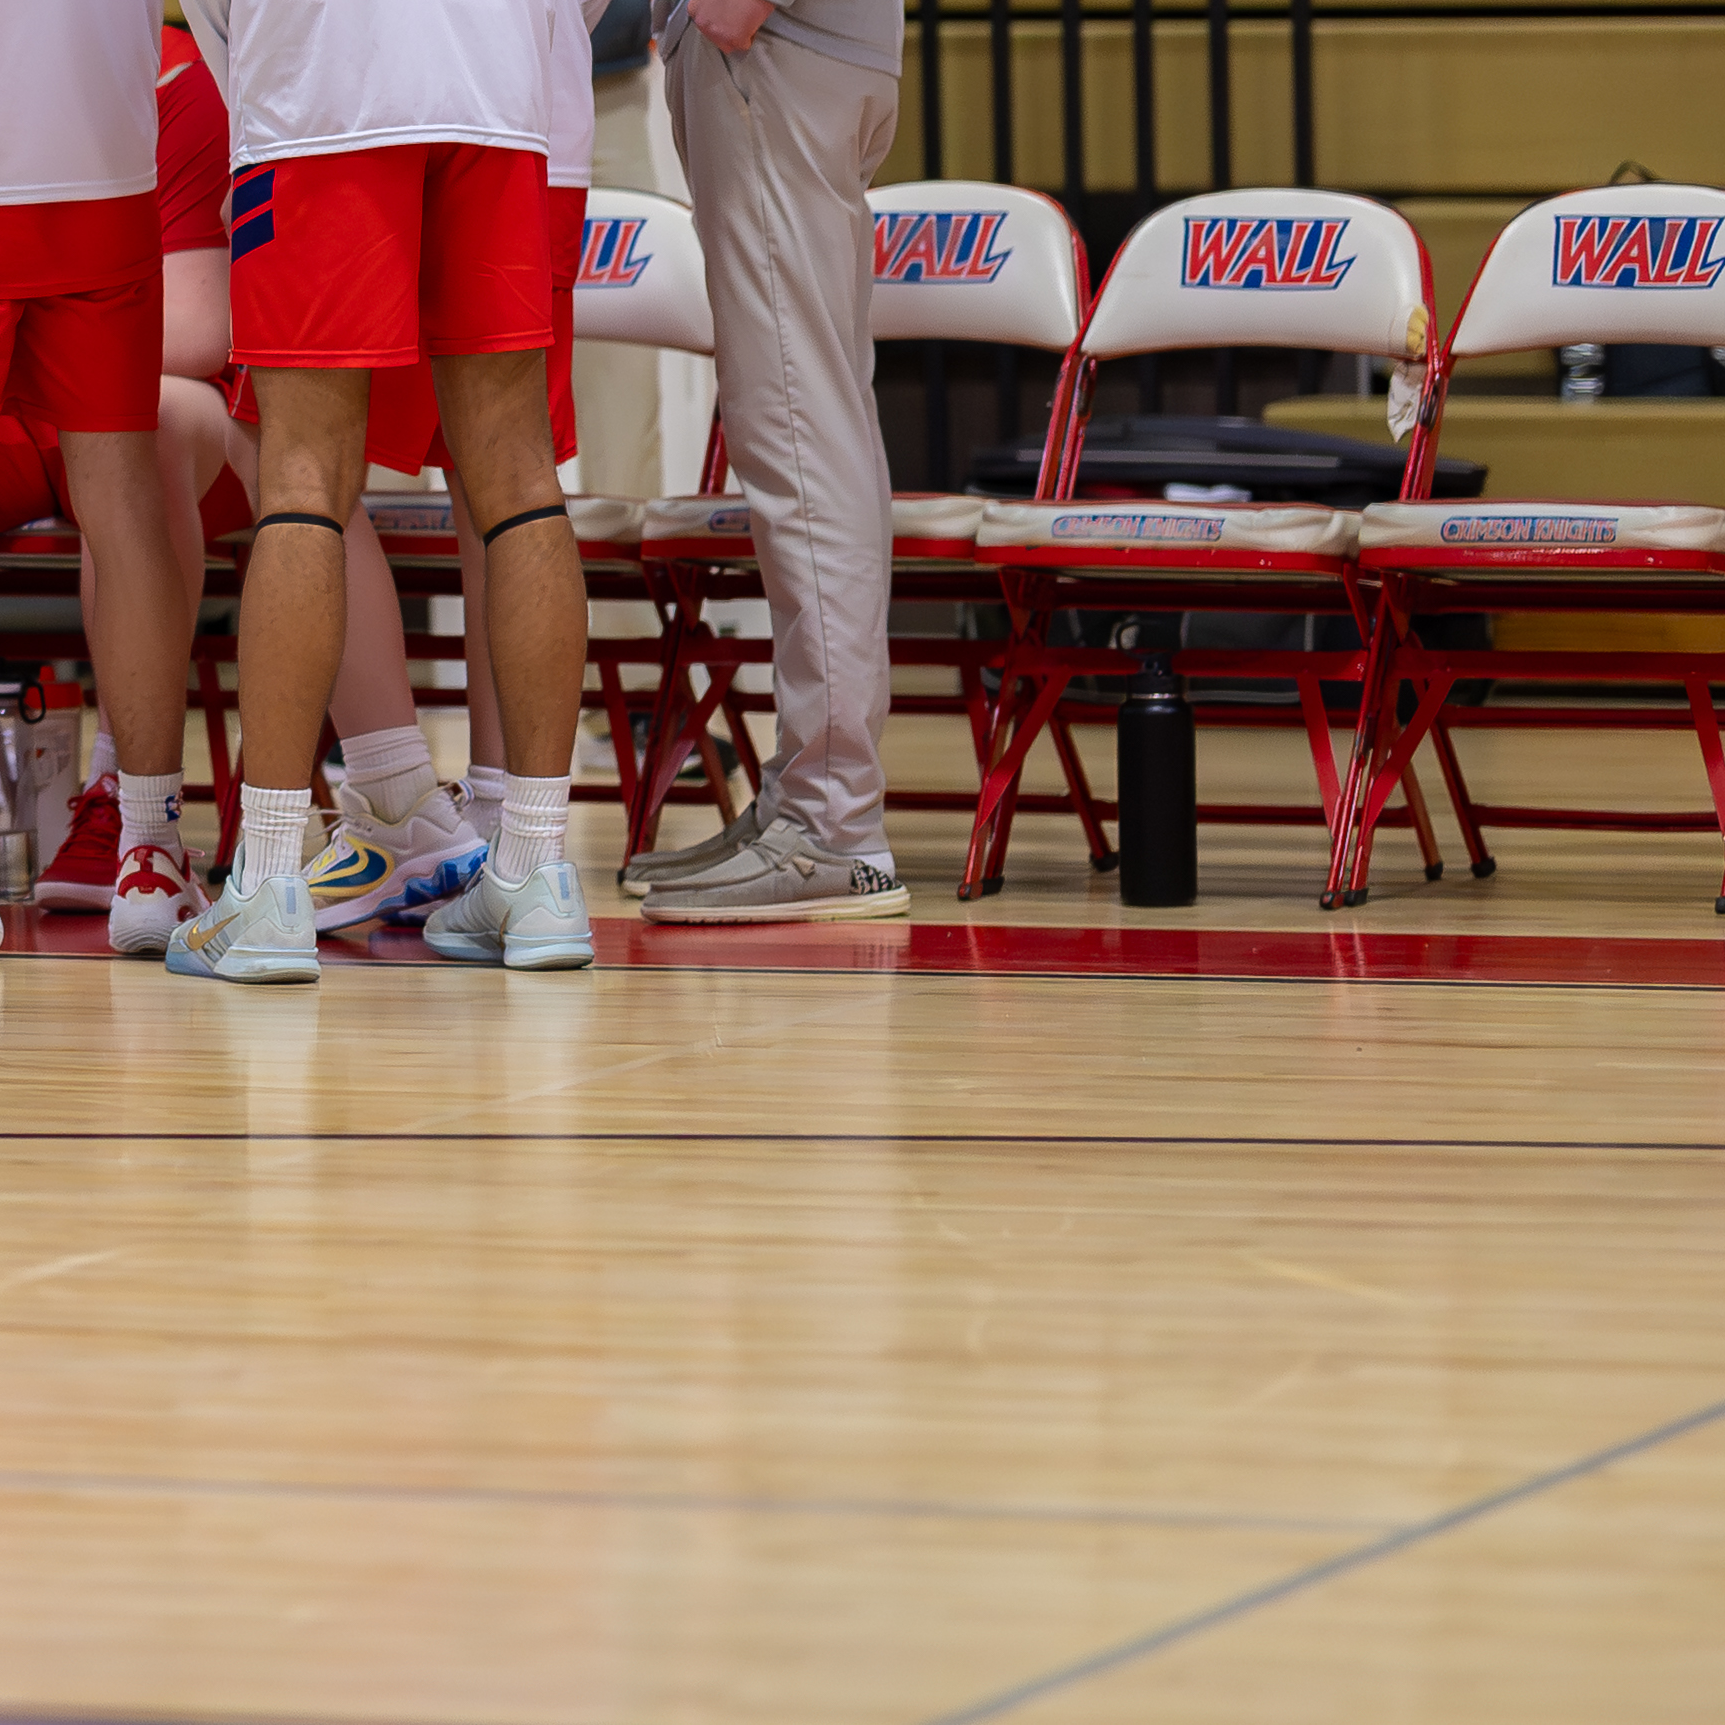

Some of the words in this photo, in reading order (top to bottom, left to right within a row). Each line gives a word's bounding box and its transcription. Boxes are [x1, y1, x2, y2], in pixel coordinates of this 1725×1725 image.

[1182, 217, 1356, 290] WALL
[1553, 216, 1725, 289] WALL
[1141, 515, 1223, 541] KNIGHTS
[1443, 518, 1531, 542] CRIMSON
[1532, 518, 1616, 542] KNIGHTS
